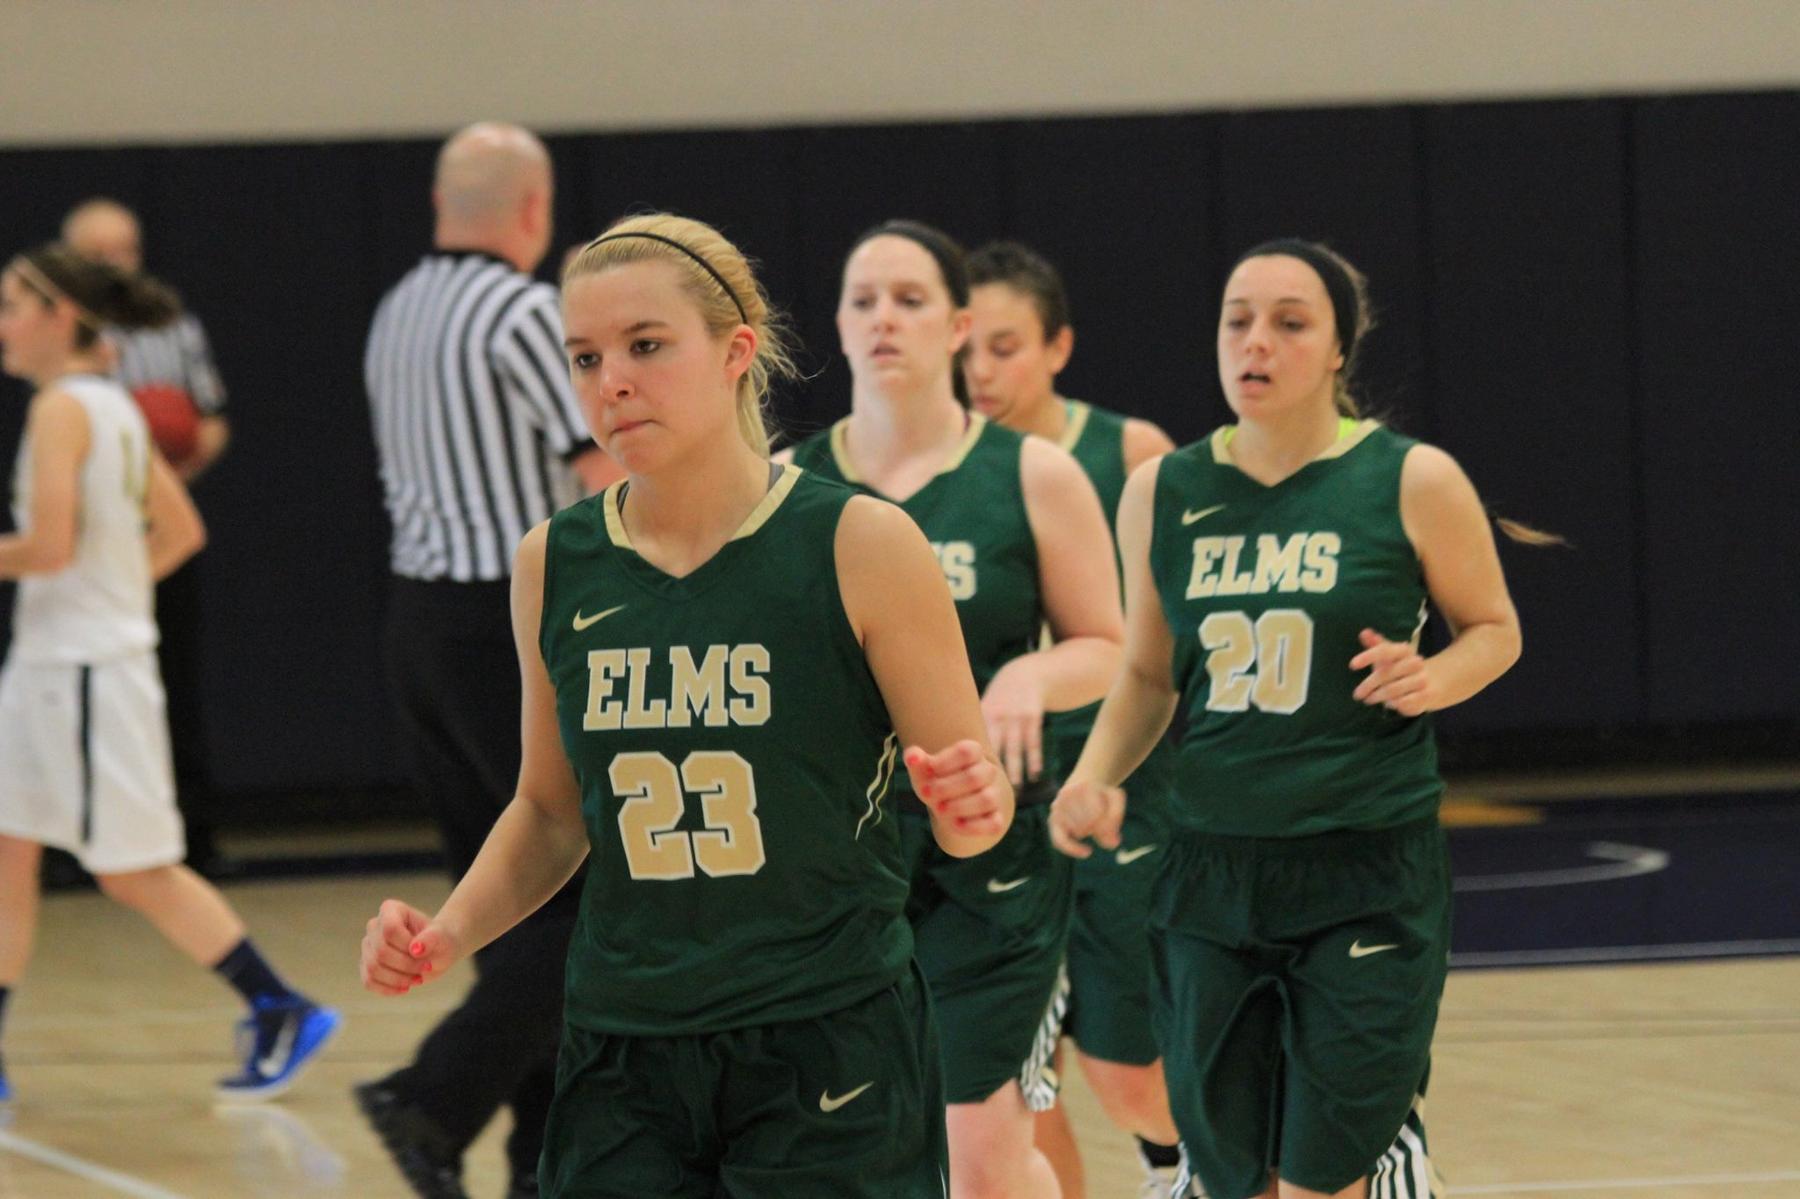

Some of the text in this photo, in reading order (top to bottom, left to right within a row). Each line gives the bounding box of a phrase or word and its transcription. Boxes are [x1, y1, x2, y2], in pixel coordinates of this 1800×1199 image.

[1185, 532, 1341, 600] ELMS
[583, 643, 771, 731] ELMS
[1198, 608, 1314, 715] 20
[608, 751, 766, 880] 23
